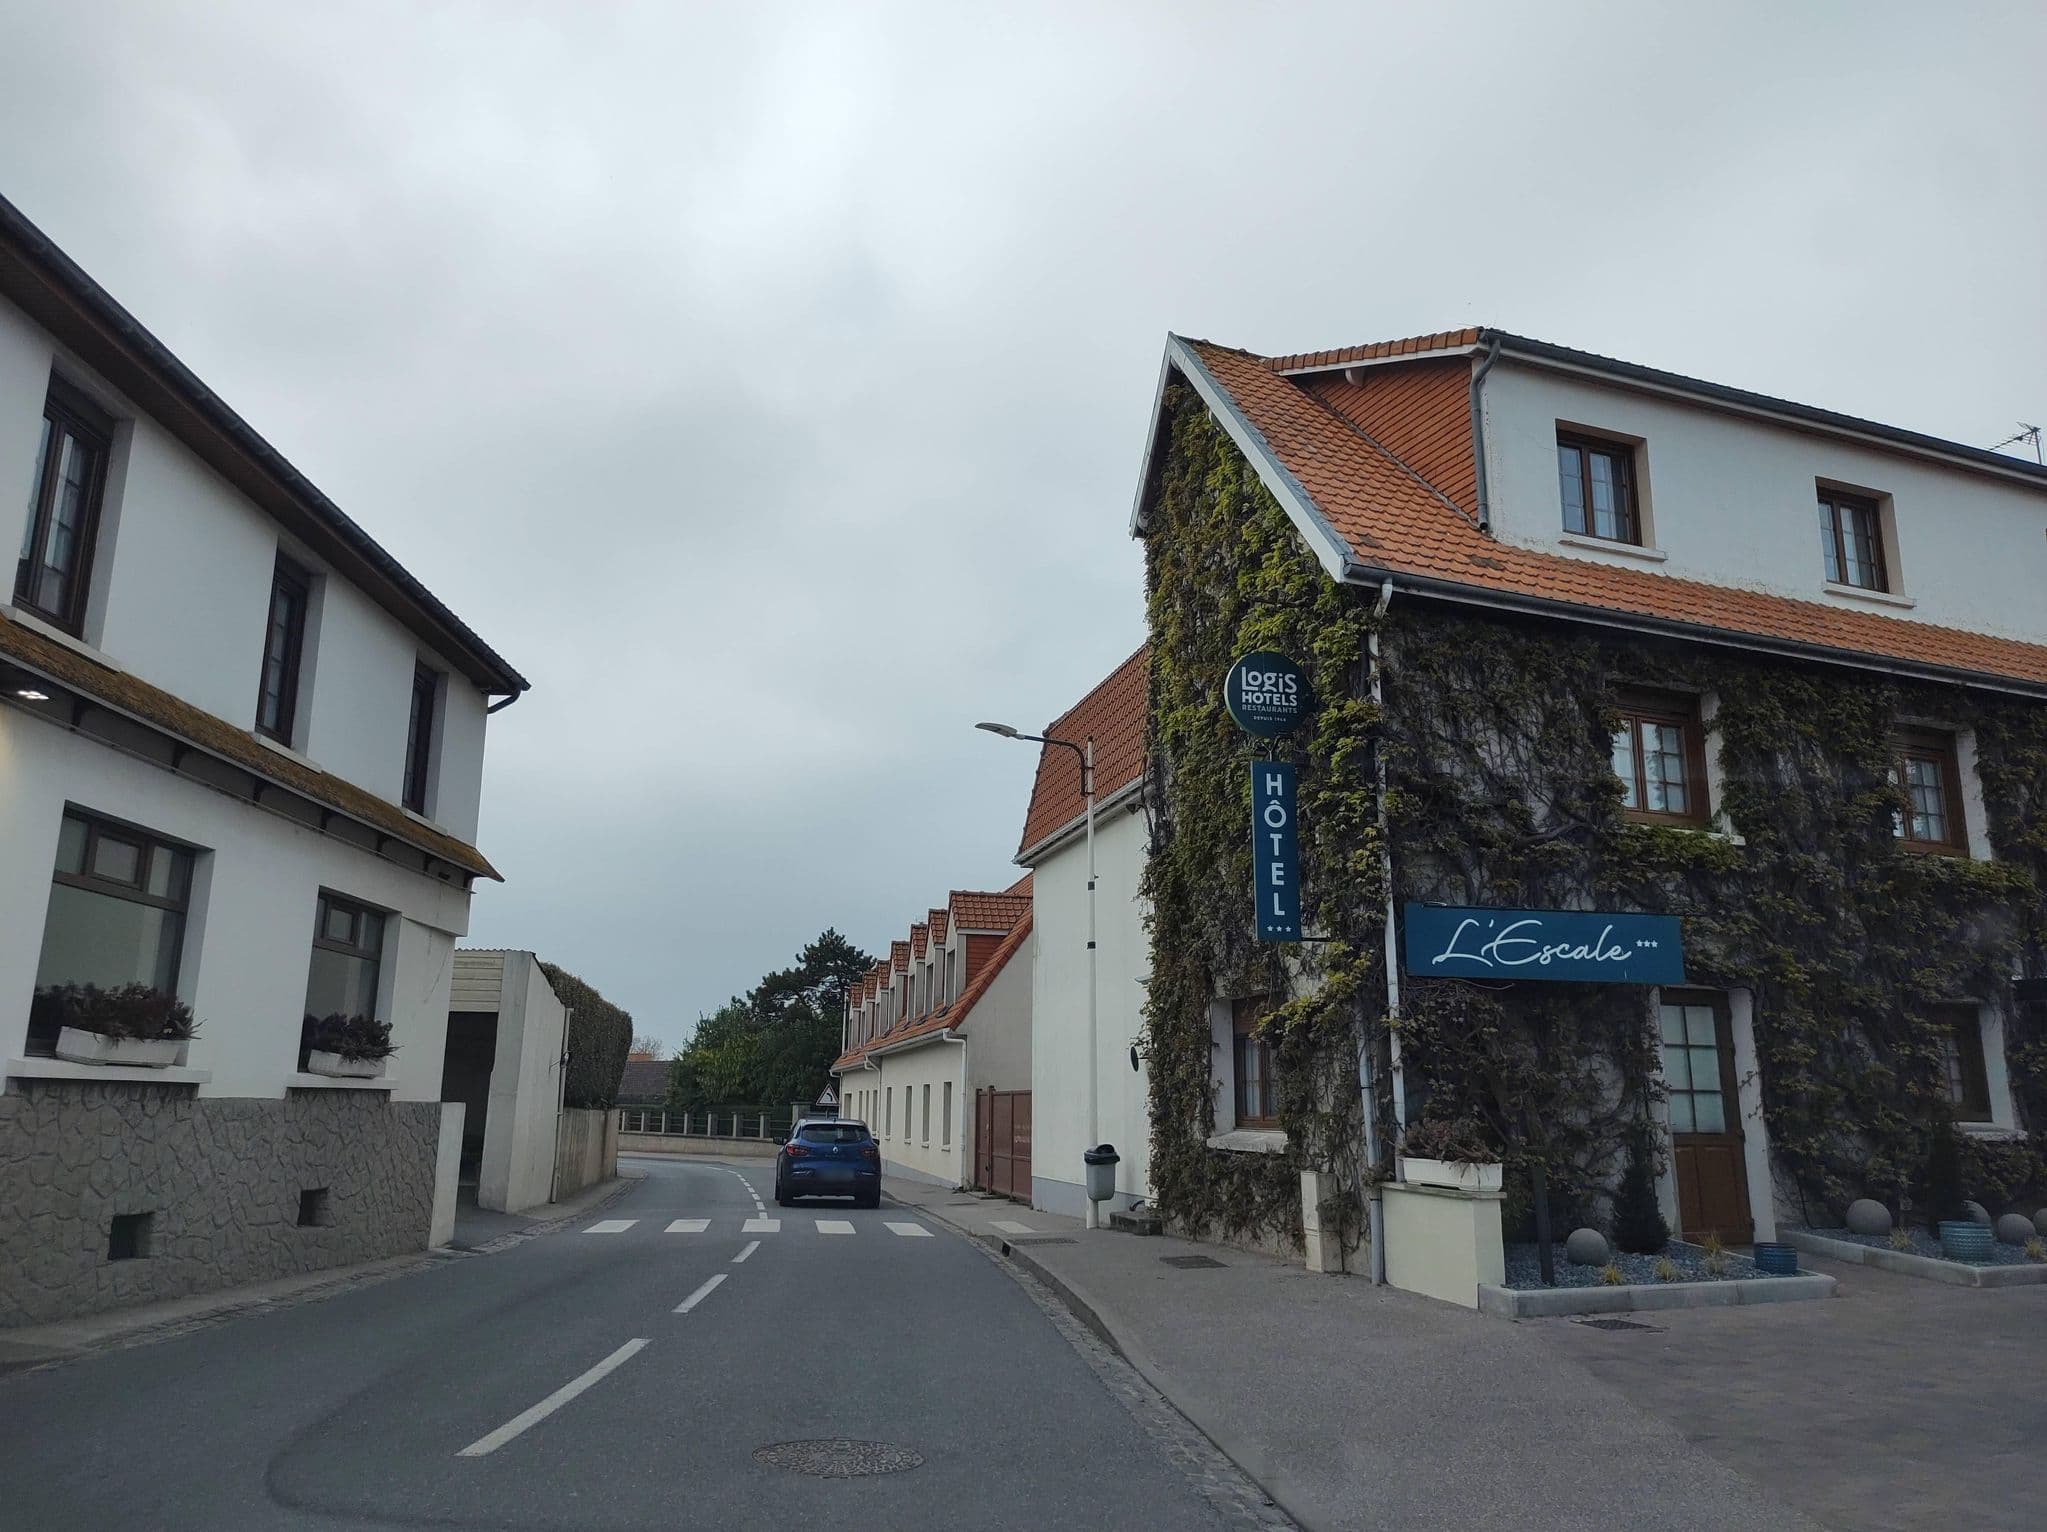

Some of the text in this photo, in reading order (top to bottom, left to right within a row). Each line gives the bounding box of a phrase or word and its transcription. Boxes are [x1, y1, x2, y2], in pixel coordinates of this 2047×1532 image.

[1241, 691, 1298, 707] HOTELS
[1241, 704, 1298, 714] RESTAURANTS
[1263, 772, 1287, 916] HÔTEL
[1432, 918, 1632, 967] L'Escale
